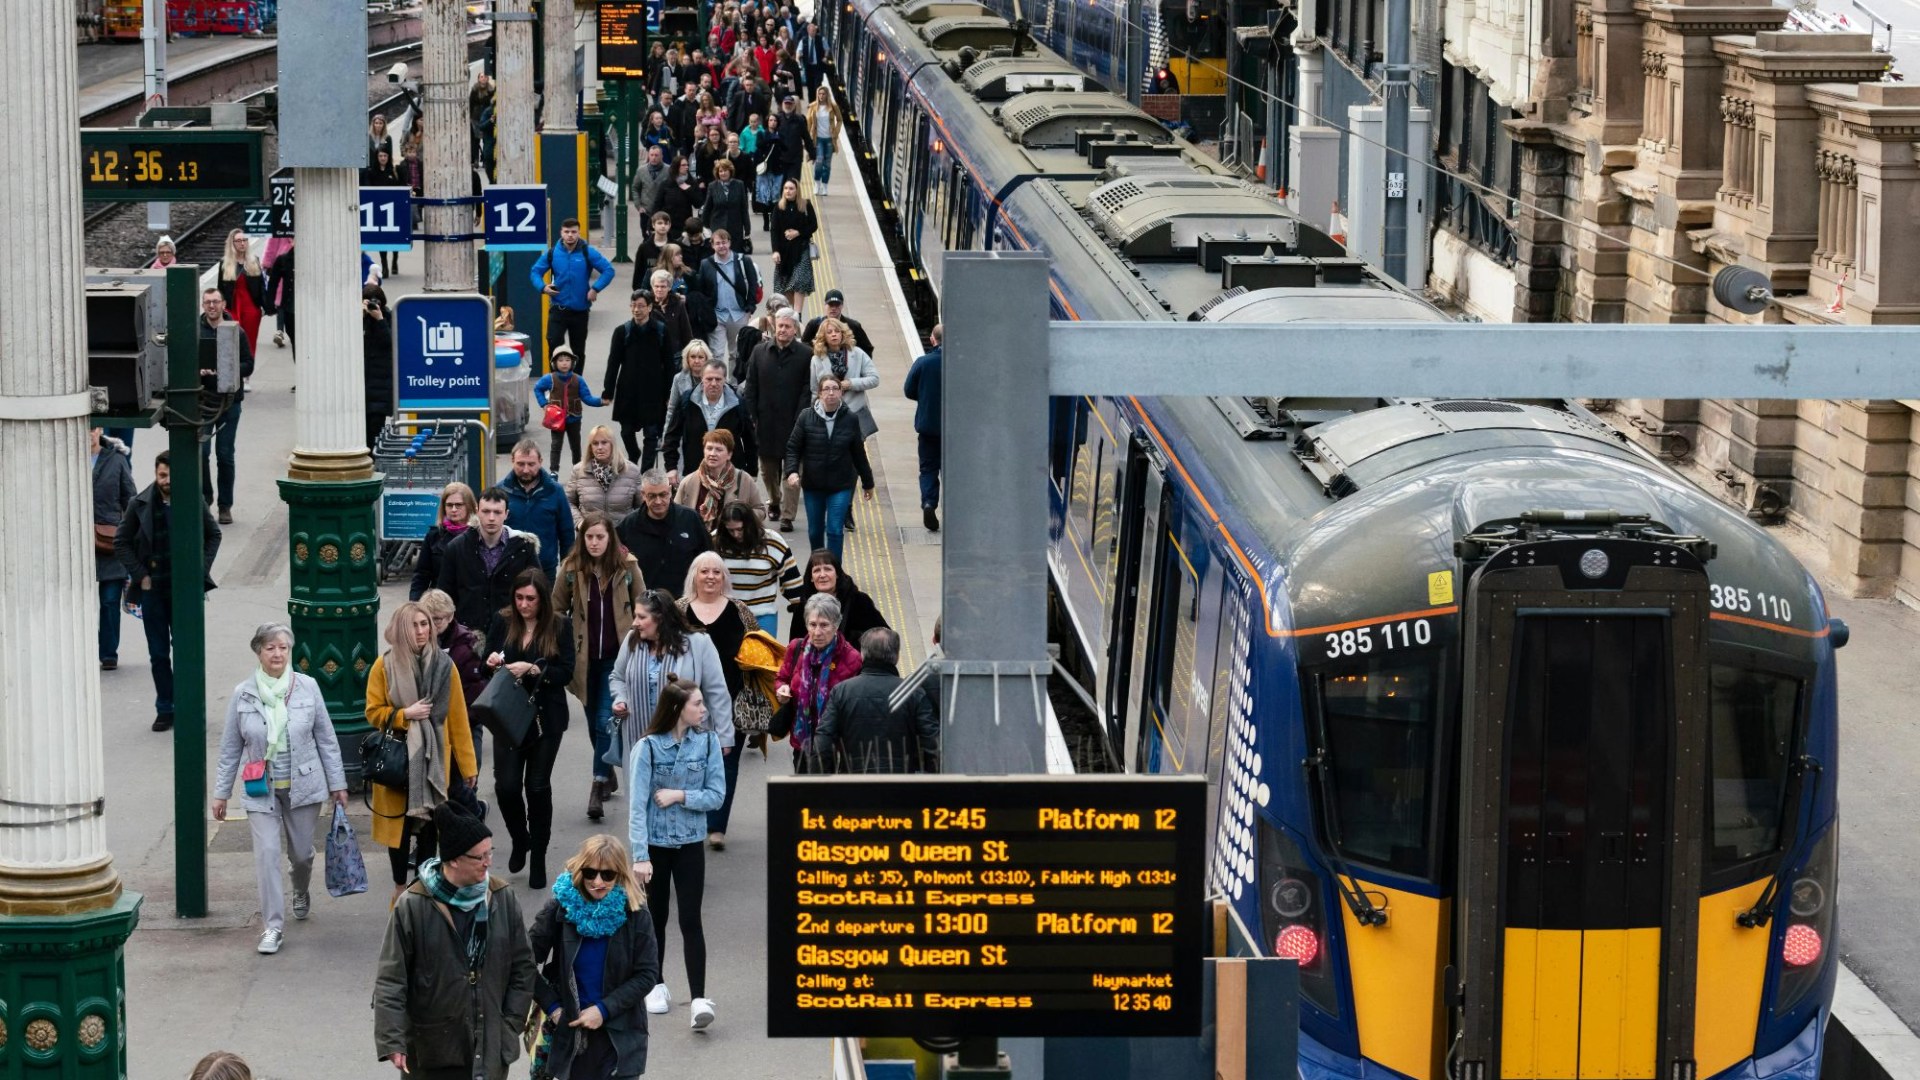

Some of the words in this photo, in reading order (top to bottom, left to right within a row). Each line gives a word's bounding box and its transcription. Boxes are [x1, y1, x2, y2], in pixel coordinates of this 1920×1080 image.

[244, 209, 272, 226] ZZ
[280, 209, 292, 228] 4
[360, 202, 400, 232] 11
[493, 202, 536, 232] 12
[407, 375, 446, 389] Trolley
[448, 375, 481, 389] point
[388, 500, 414, 508] Edinburgh
[1710, 583, 1752, 612] 385
[1757, 592, 1792, 622] 110
[1325, 627, 1373, 659] 385
[1381, 619, 1431, 649] 110
[801, 808, 827, 830] 1st
[832, 814, 913, 833] departure
[921, 807, 987, 830] 12:45
[1038, 807, 1140, 830] Platform
[1154, 808, 1177, 830] 12
[797, 840, 890, 865] Glasgow
[900, 840, 972, 864] Queen
[982, 840, 1010, 862] St
[796, 869, 848, 888] Calling
[853, 870, 875, 886] at:
[913, 869, 975, 885] Polmont
[979, 870, 1036, 888] (13:10),
[1040, 869, 1095, 885] Falkirk
[1099, 870, 1132, 888] High
[797, 890, 915, 906] ScotRail
[925, 889, 1036, 907] Express
[796, 912, 830, 934] 2nd
[835, 919, 915, 937] departure
[924, 912, 988, 934] 13:00
[1036, 912, 1138, 934] Platform
[1151, 912, 1174, 934] 12
[796, 944, 889, 969] Glasgow
[899, 944, 971, 967] Queen
[980, 944, 1008, 966] St
[796, 973, 847, 992] Calling
[852, 973, 874, 989] at:
[1092, 973, 1174, 991] Haymarket
[796, 993, 914, 1009] ScotRail
[924, 993, 1033, 1010] Express
